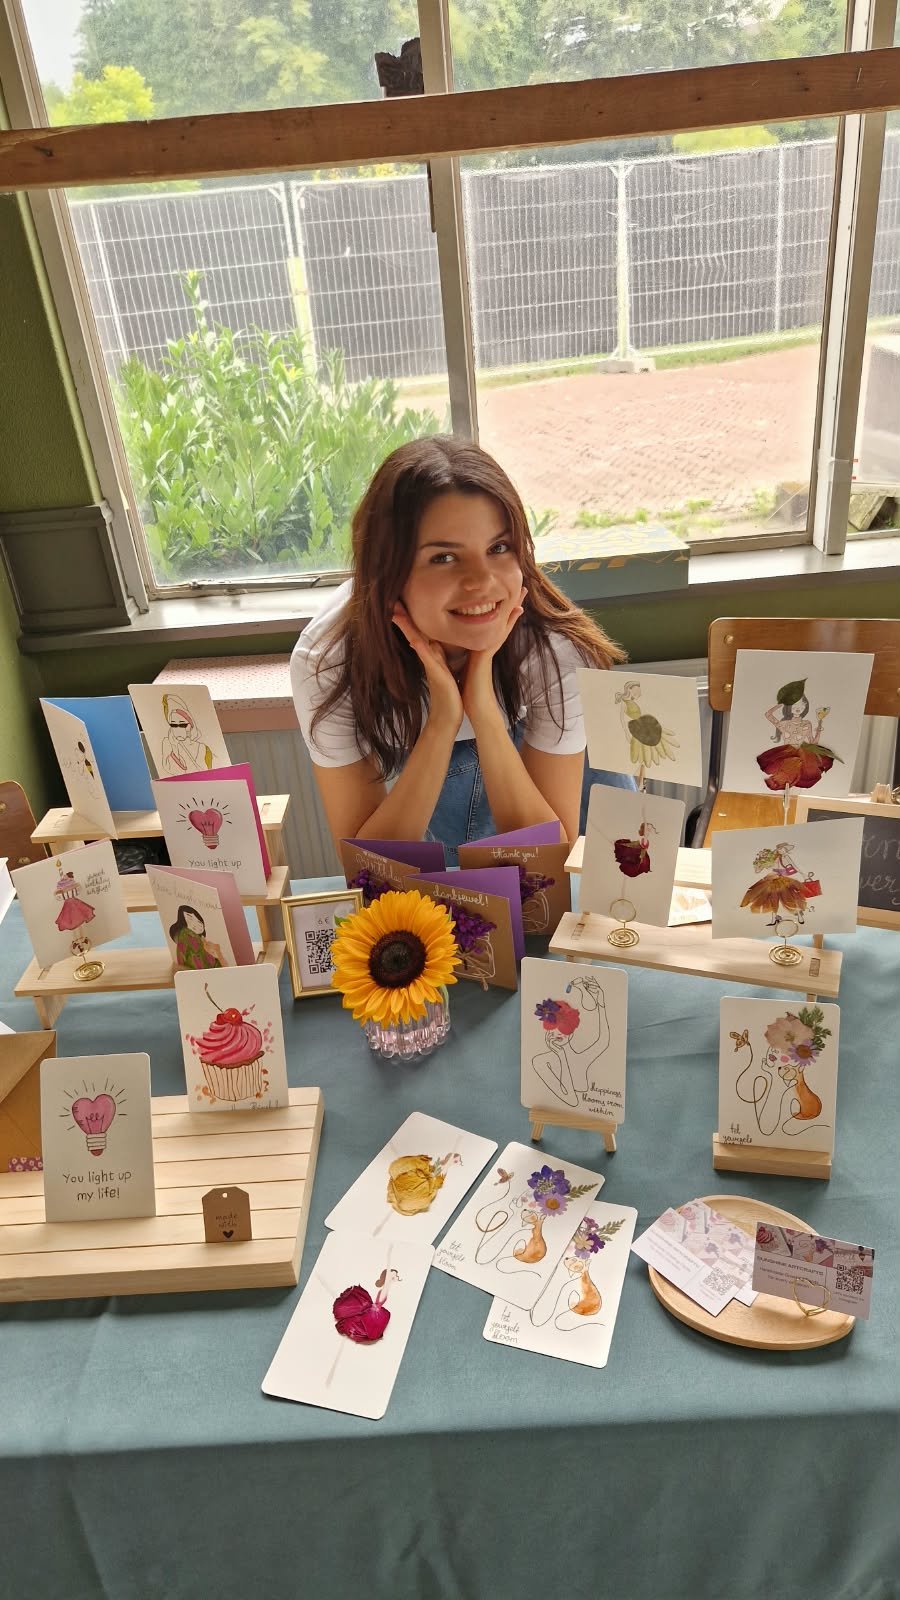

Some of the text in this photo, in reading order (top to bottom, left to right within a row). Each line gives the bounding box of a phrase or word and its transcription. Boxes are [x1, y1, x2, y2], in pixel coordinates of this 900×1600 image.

[491, 848, 540, 862] thank you!
[188, 858, 242, 869] You light up
[432, 884, 489, 907] dankjewel!
[589, 1107, 615, 1117] within
[62, 1170, 132, 1186] You light up
[77, 1187, 120, 1203] my life!
[216, 1212, 239, 1221] made
[218, 1221, 238, 1229] with
[788, 1263, 824, 1276] ARTCRAFTS
